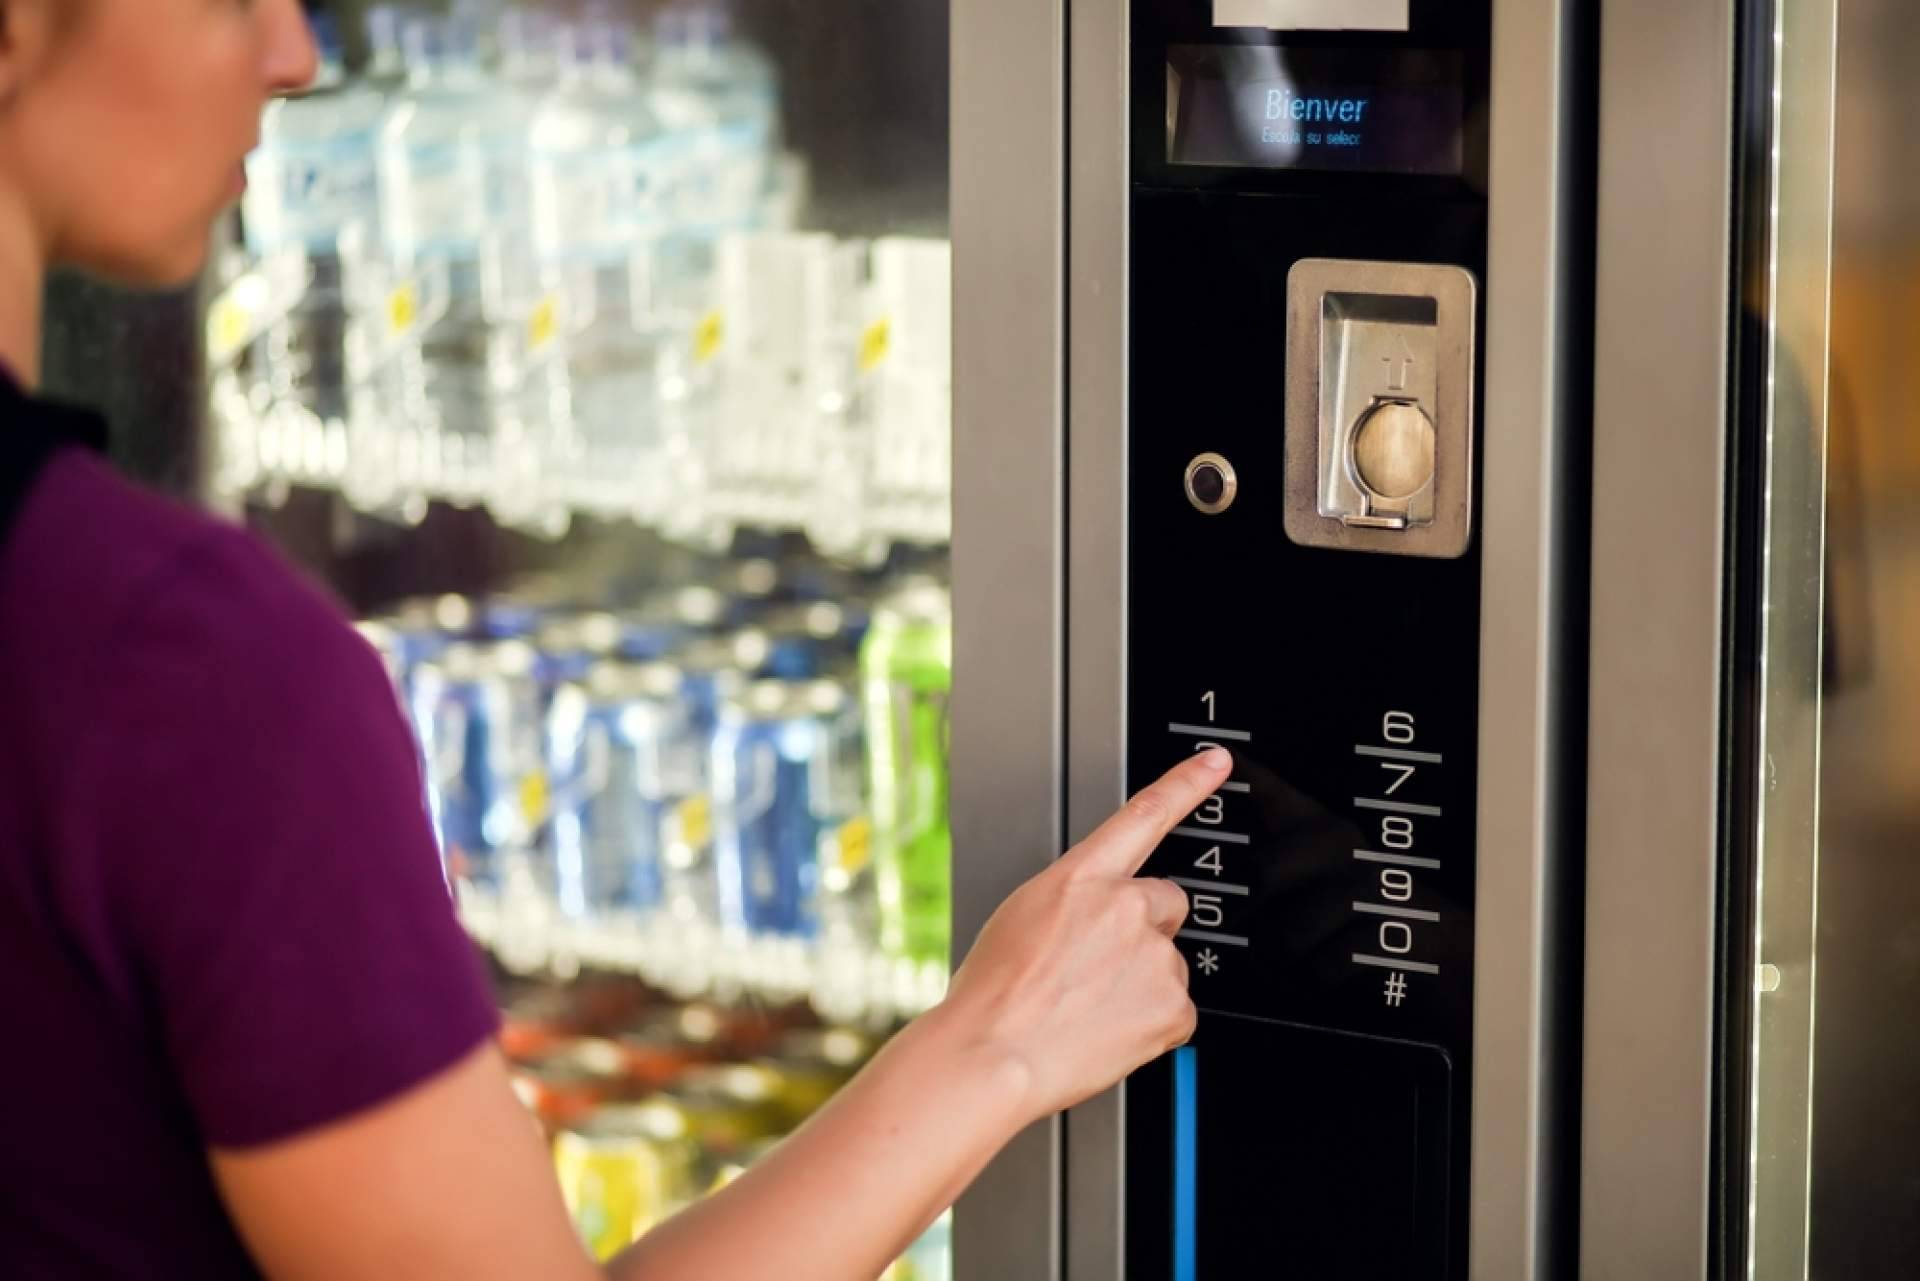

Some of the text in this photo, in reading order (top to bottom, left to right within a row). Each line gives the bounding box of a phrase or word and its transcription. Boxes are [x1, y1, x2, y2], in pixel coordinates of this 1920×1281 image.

[1306, 132, 1322, 145] su
[1201, 690, 1215, 721] 1
[1383, 710, 1414, 744] 6
[1380, 762, 1416, 795] 7
[1195, 795, 1223, 824] 3
[1381, 815, 1414, 849] 8
[1193, 845, 1223, 876] 4
[1380, 868, 1413, 901] 9
[1192, 894, 1223, 927] 5
[1379, 921, 1412, 953] 0
